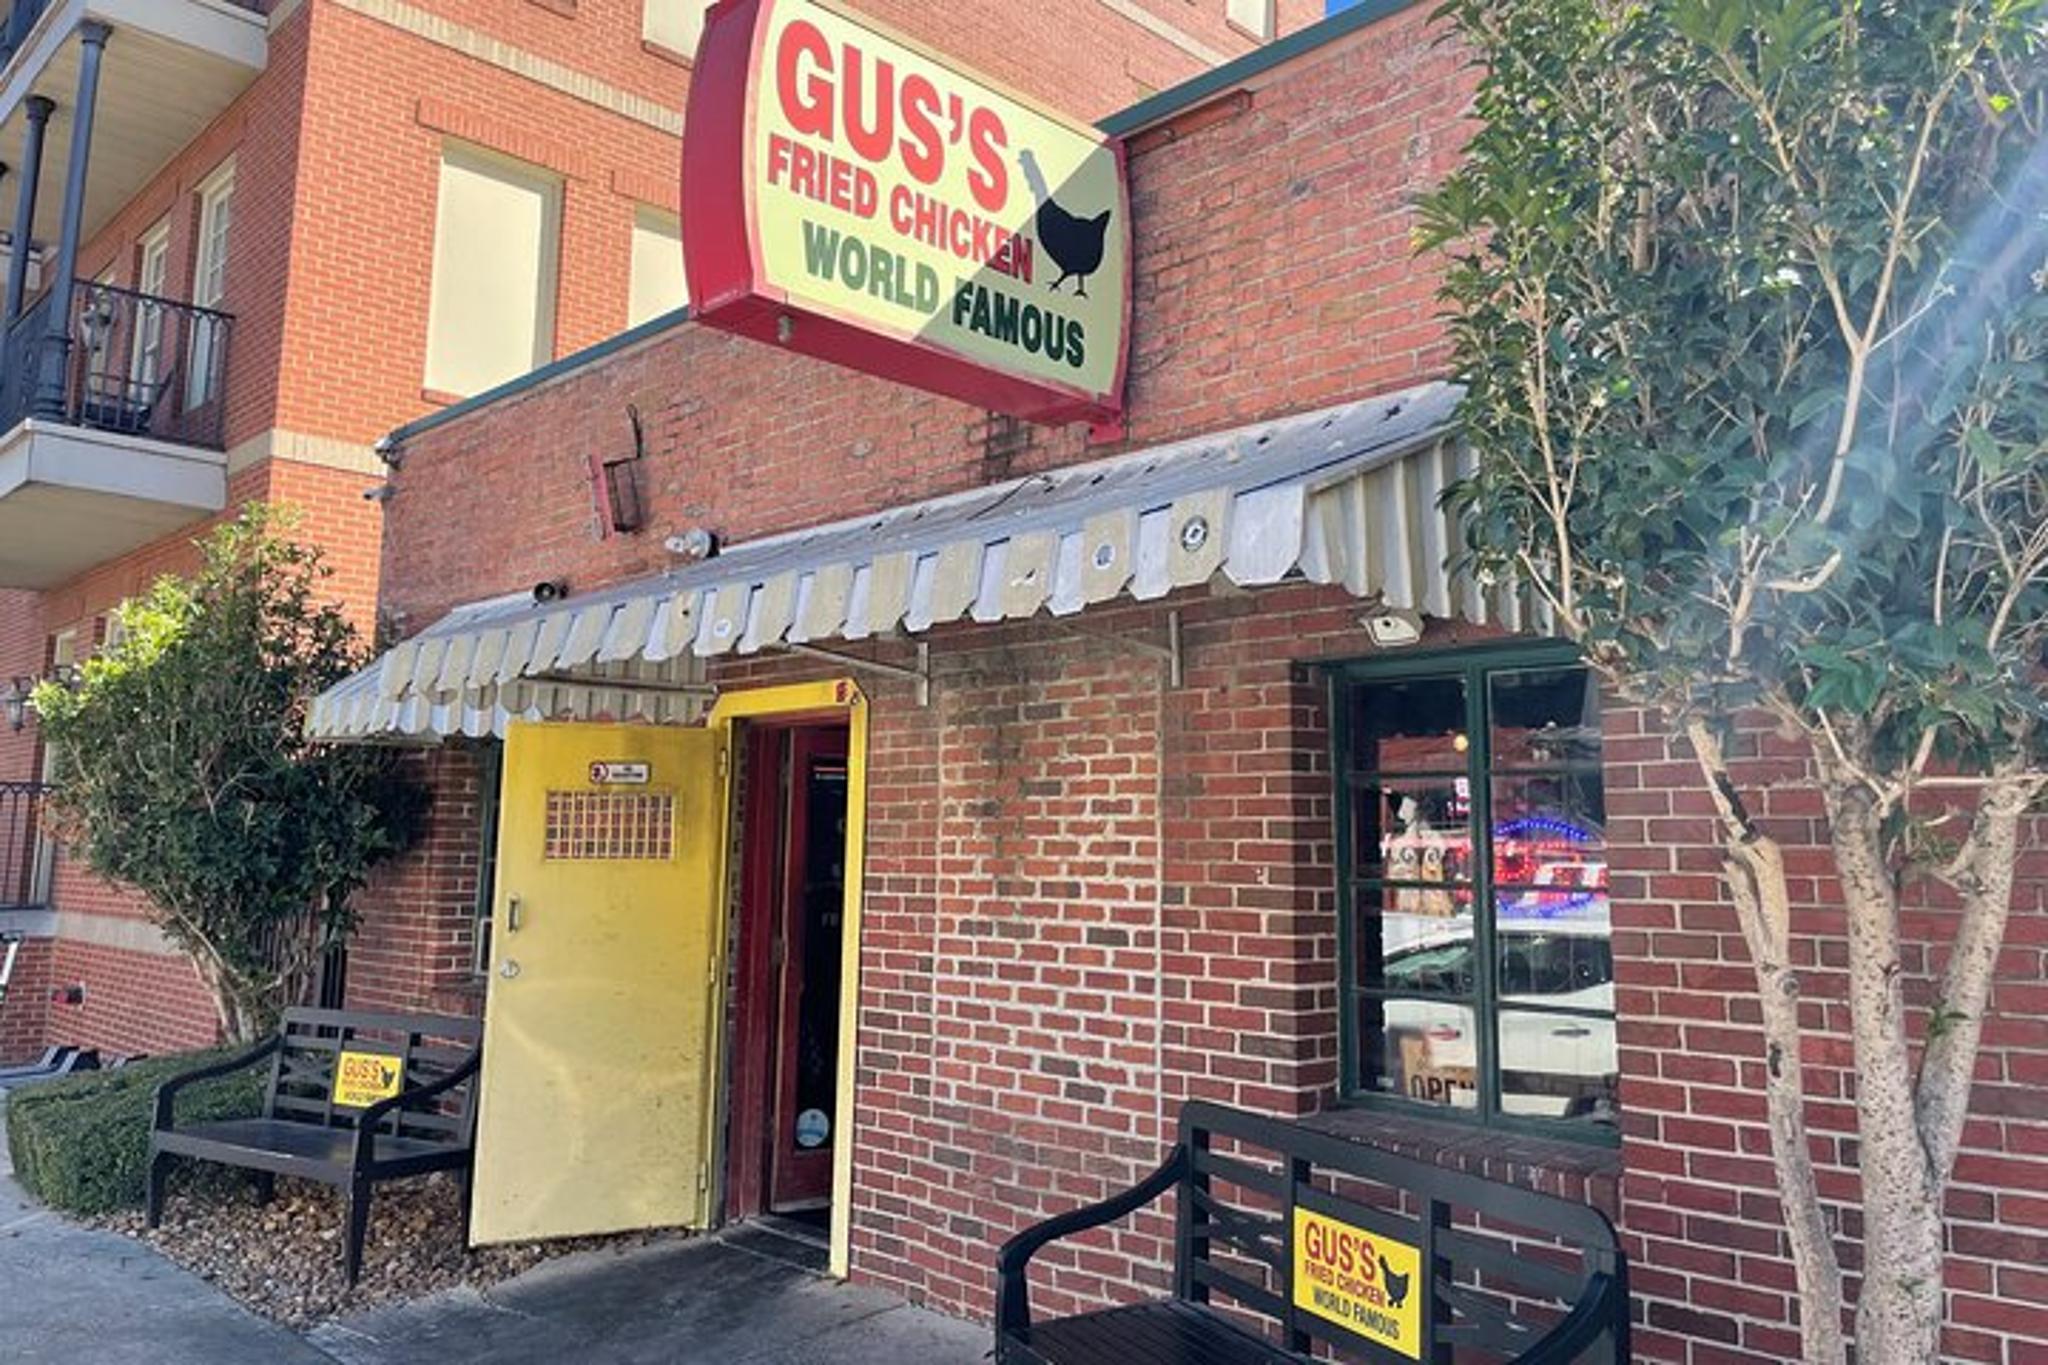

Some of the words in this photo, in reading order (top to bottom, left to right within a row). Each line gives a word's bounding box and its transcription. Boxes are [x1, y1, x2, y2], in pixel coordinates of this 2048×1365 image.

[776, 19, 1008, 212] GUS'S
[768, 133, 878, 219] FRIED
[889, 184, 1034, 284] CHICKEN
[802, 220, 940, 315] WORLD
[952, 276, 1085, 368] FAMOUS
[1304, 1260, 1334, 1286] FRIED
[1337, 1272, 1386, 1308] CHICKEN
[1305, 1221, 1377, 1281] GUS'S
[1312, 1286, 1351, 1318] WORLD
[1353, 1302, 1399, 1340] FAMOUS
